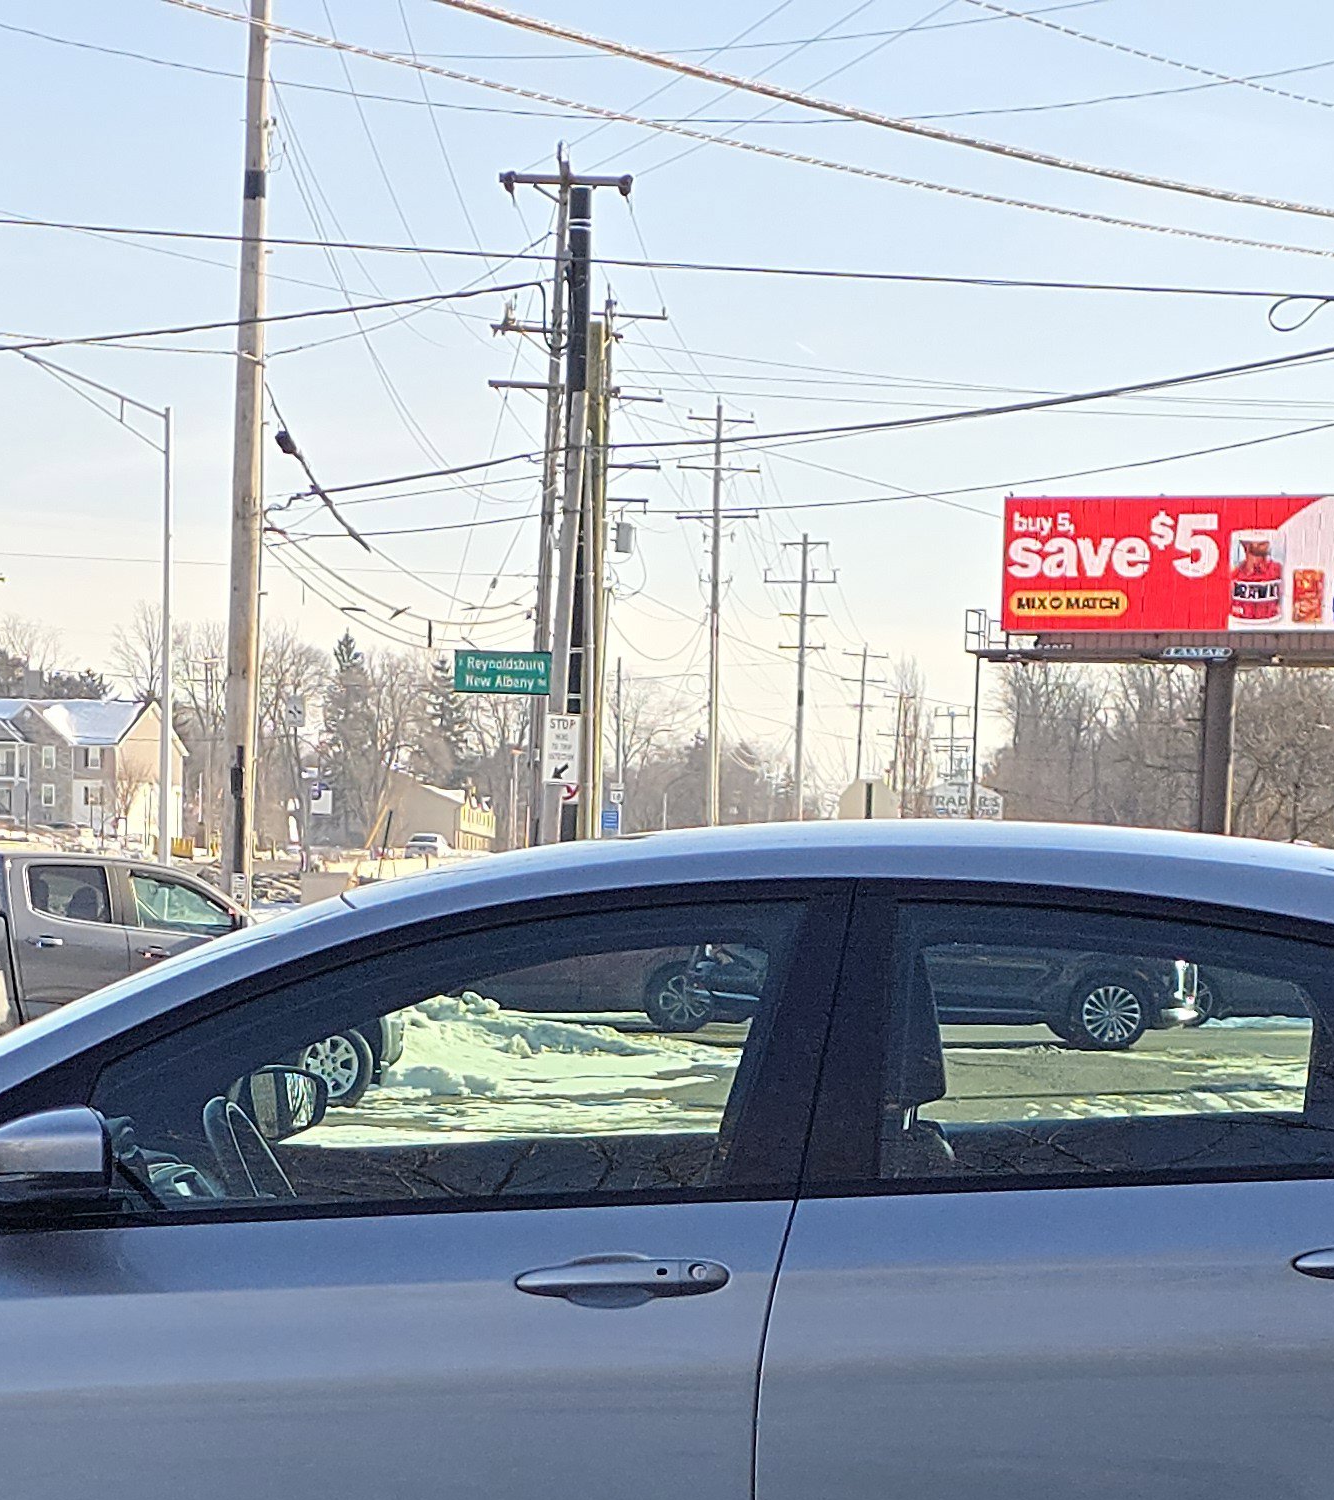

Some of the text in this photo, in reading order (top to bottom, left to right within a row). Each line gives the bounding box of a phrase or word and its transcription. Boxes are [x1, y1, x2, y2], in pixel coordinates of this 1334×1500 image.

[1014, 512, 1075, 536] buy 5,
[1007, 510, 1220, 578] save $5
[1017, 597, 1048, 609] MIX
[1066, 597, 1120, 609] MATCH
[467, 656, 546, 675] Reynoldsburg
[465, 674, 492, 687] New
[495, 674, 535, 691] Albany
[549, 718, 576, 729] STOP
[928, 795, 1000, 807] TRADRS
